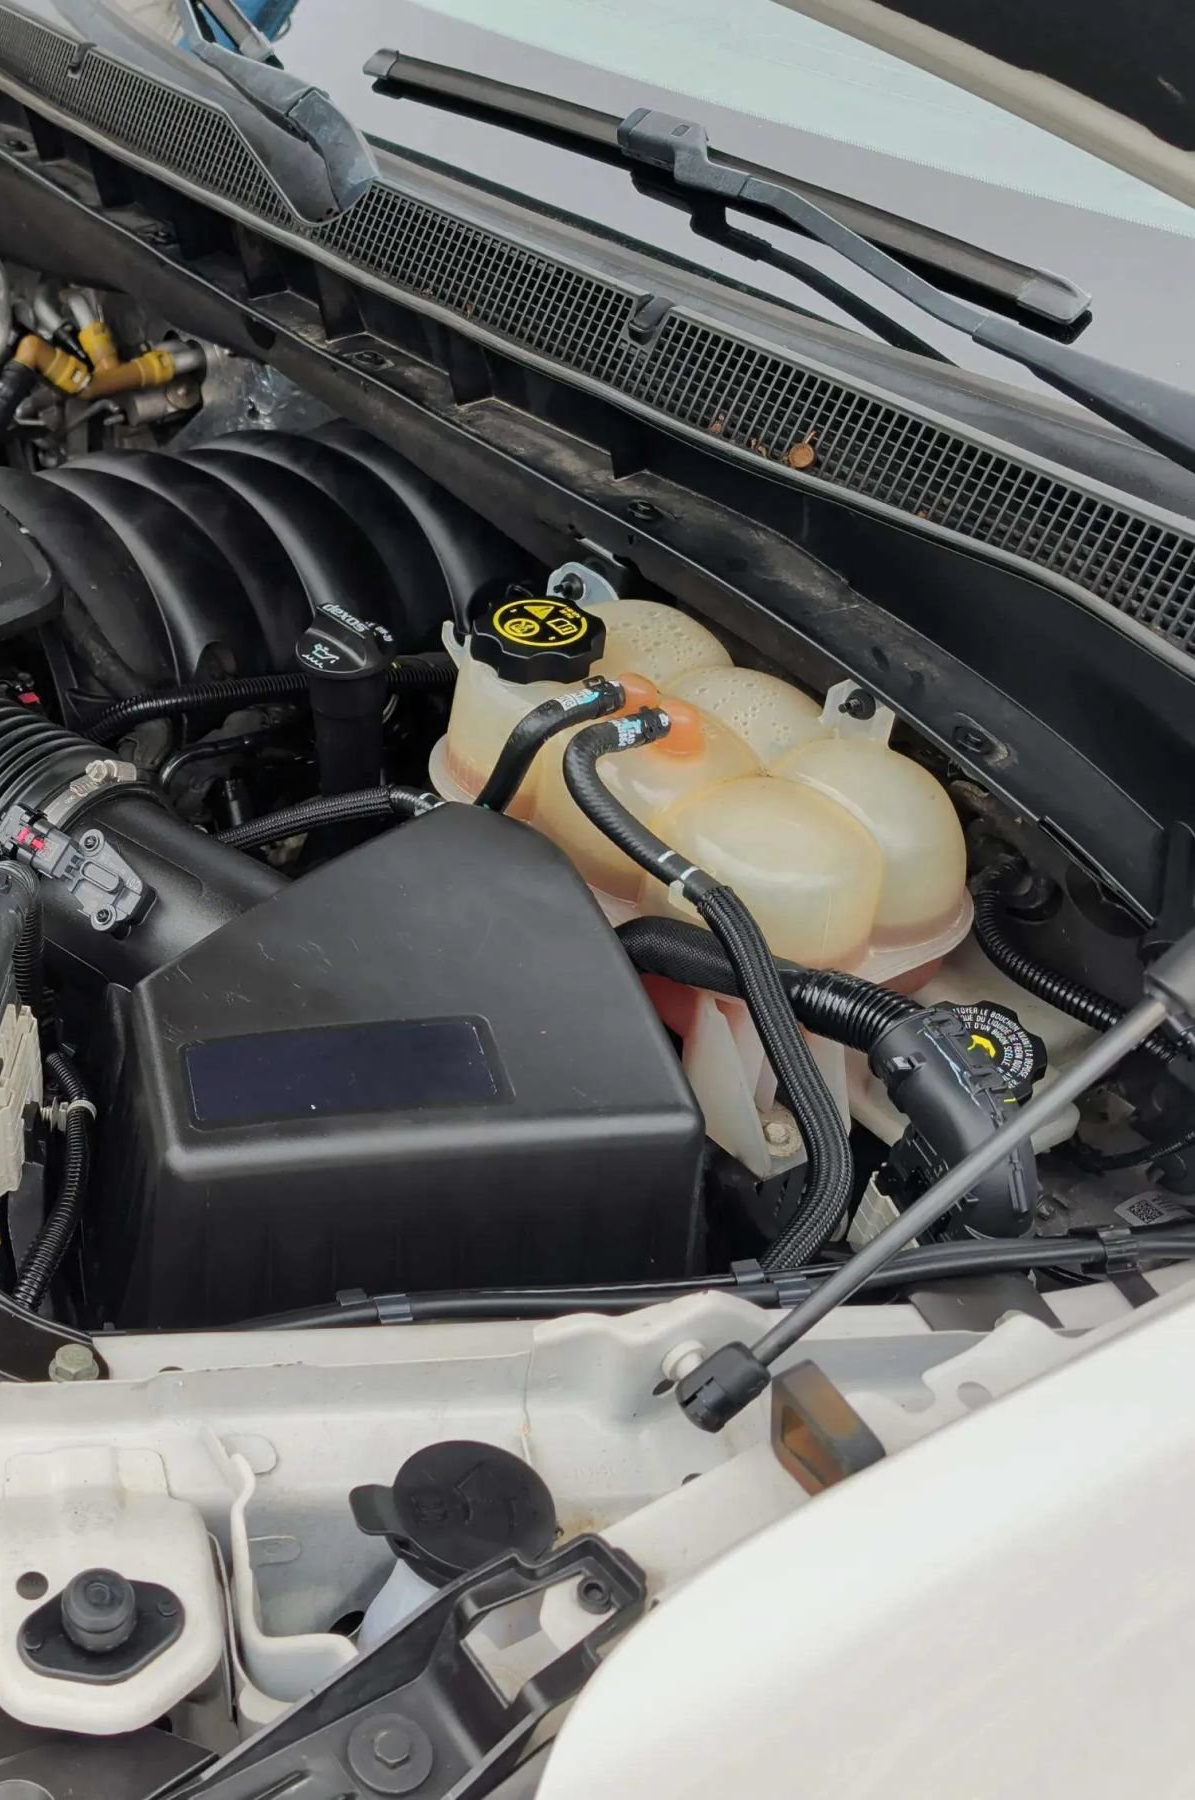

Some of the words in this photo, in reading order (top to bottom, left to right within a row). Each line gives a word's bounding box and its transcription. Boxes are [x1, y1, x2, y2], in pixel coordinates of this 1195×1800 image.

[322, 604, 369, 632] dexos
[974, 1022, 992, 1032] D'UN
[991, 1029, 1009, 1045] BIDON
[976, 1015, 985, 1023] DU
[987, 1018, 1013, 1035] LIQUIDE
[990, 1011, 1020, 1032] BOUCHON
[1016, 1031, 1033, 1048] AVANT
